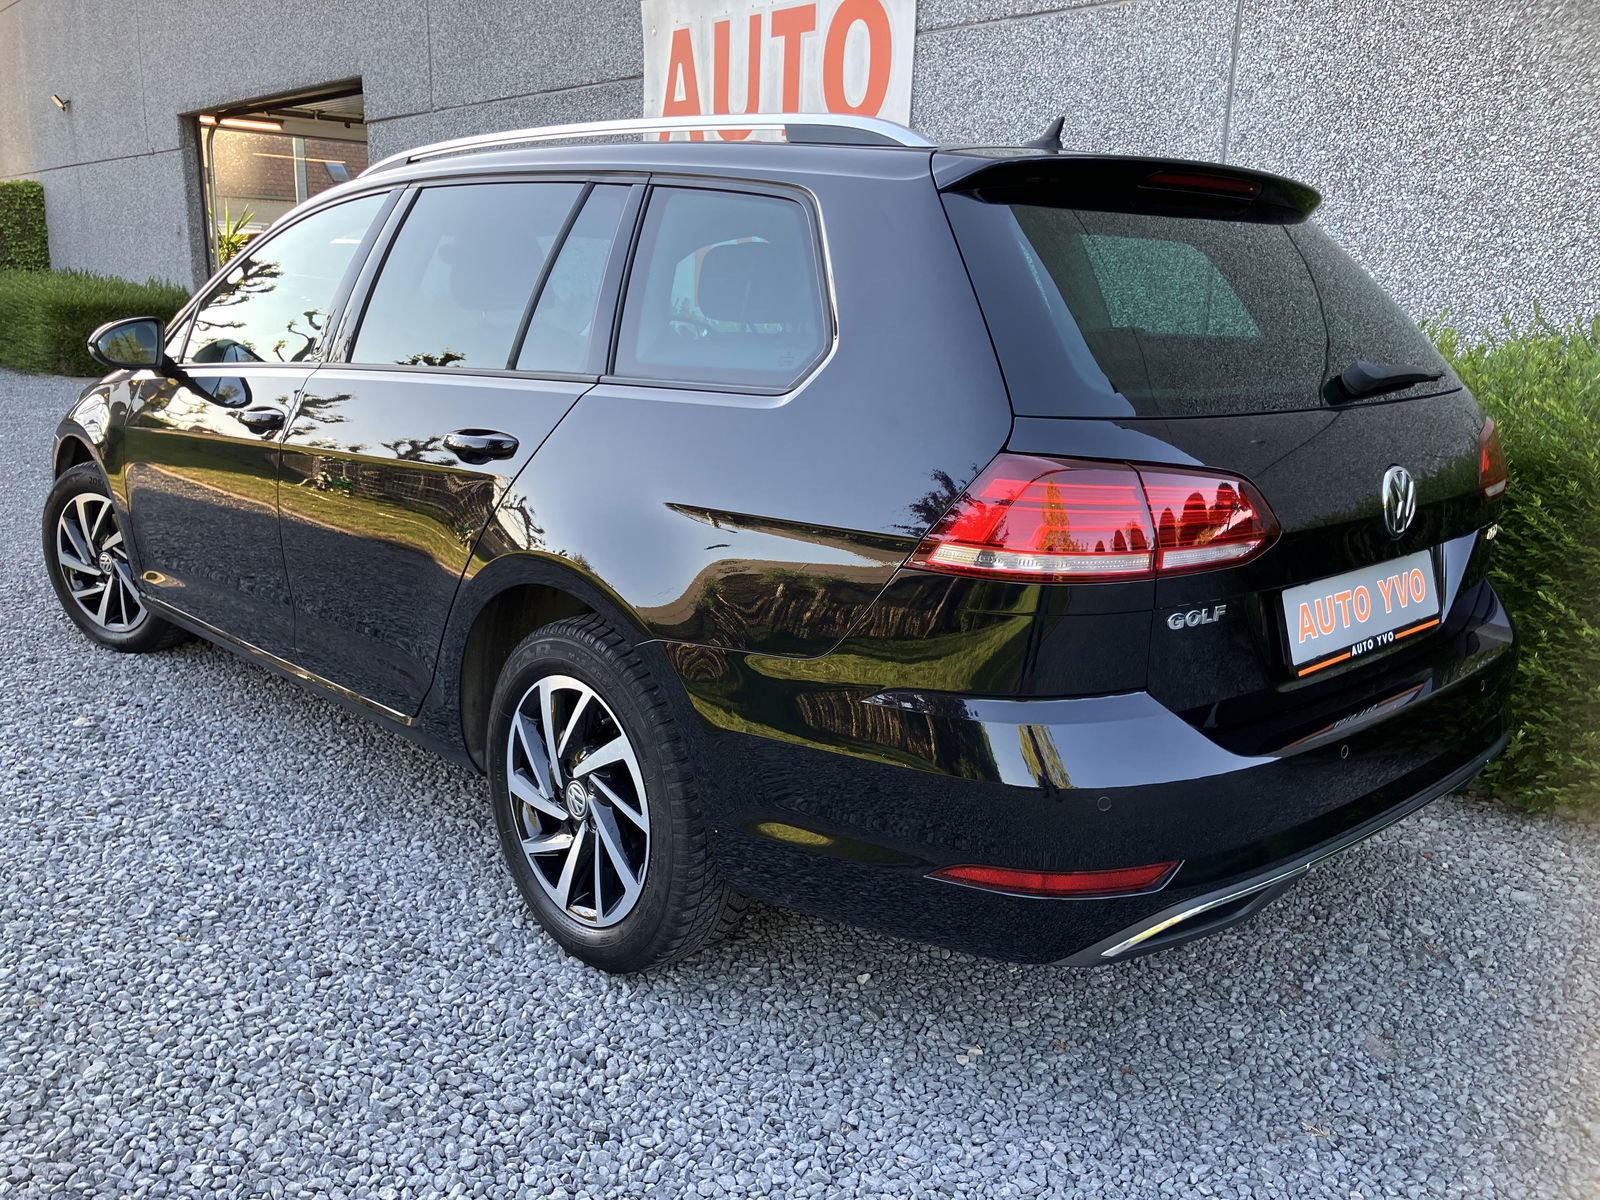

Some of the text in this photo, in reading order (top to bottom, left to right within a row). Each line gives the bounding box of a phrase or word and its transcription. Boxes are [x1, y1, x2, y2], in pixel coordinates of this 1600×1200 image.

[659, 0, 892, 142] AUTO
[1167, 604, 1227, 630] GOLF
[1298, 568, 1426, 643] AUTO YVO
[1351, 631, 1394, 656] AUTO YVO
